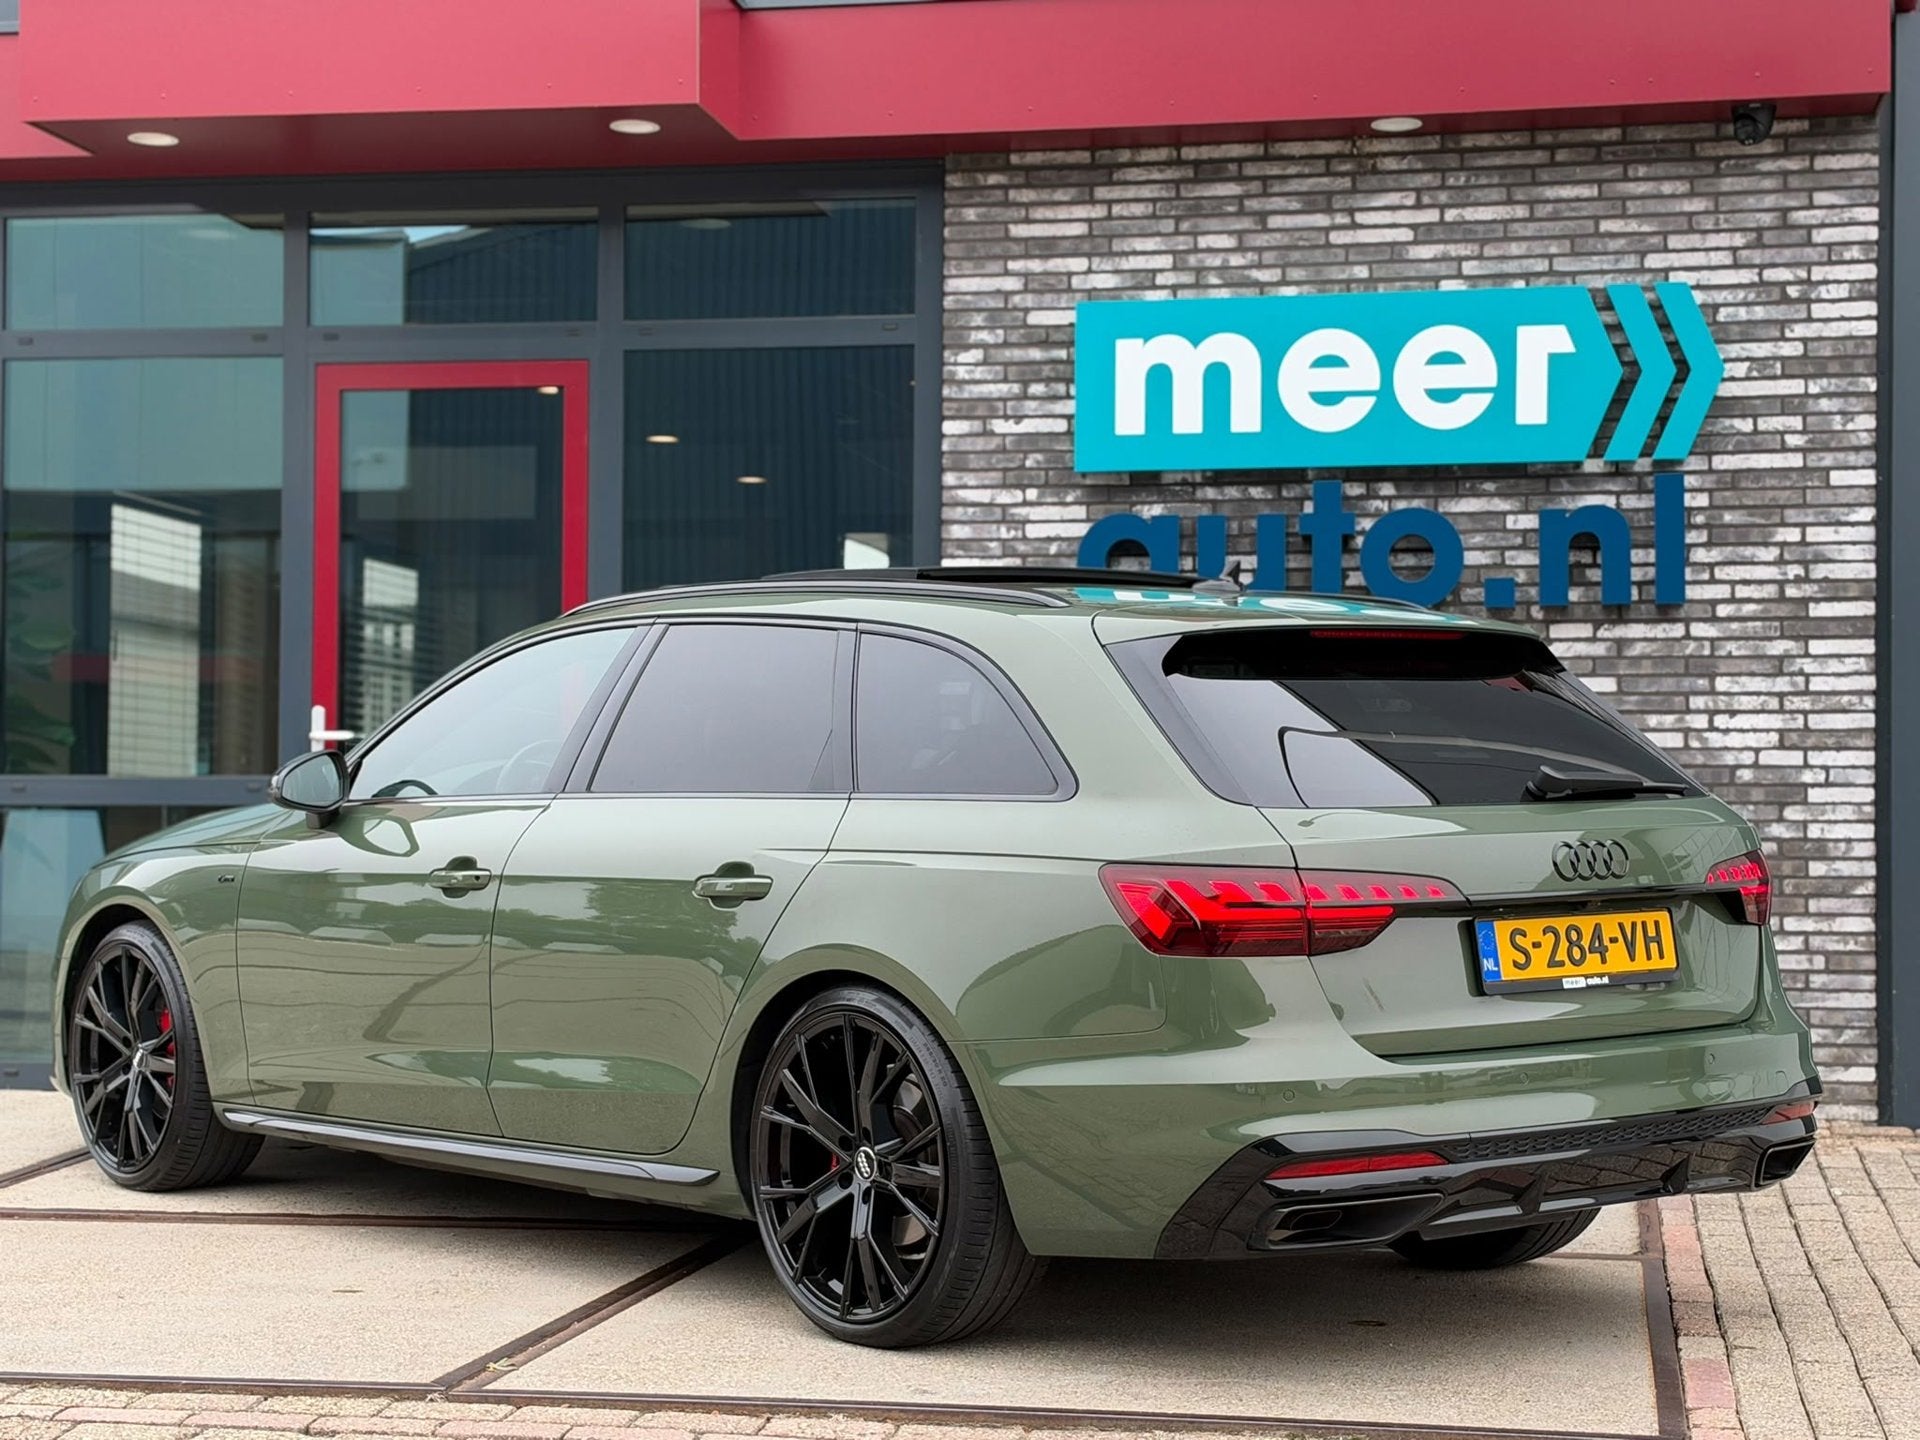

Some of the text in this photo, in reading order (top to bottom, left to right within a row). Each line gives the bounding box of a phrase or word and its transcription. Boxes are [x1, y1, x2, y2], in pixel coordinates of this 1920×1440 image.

[1114, 324, 1576, 436] meer
[1483, 957, 1499, 972] NL
[1509, 919, 1665, 971] S-284-VH
